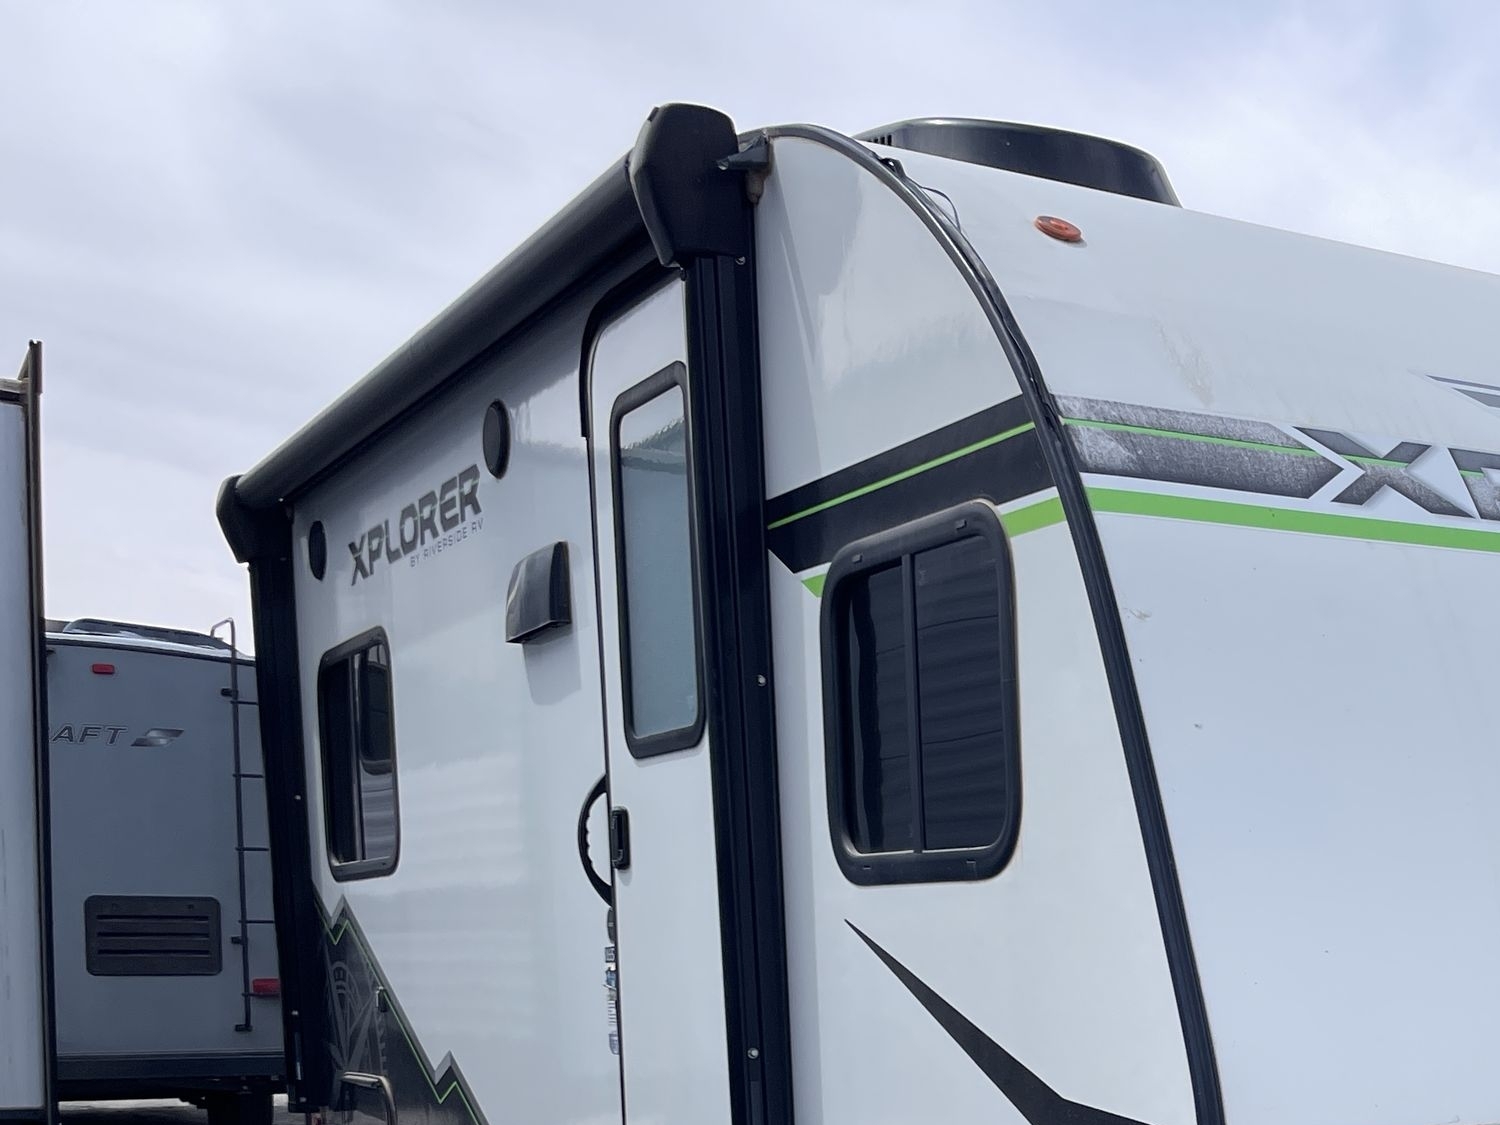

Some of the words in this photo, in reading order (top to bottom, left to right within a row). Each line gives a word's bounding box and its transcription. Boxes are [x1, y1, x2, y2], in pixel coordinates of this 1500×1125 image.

[348, 464, 482, 586] XPLORER
[410, 555, 421, 568] BY
[423, 526, 468, 561] RIVERSIDE
[471, 518, 485, 535] RV
[50, 724, 127, 745] AFT
